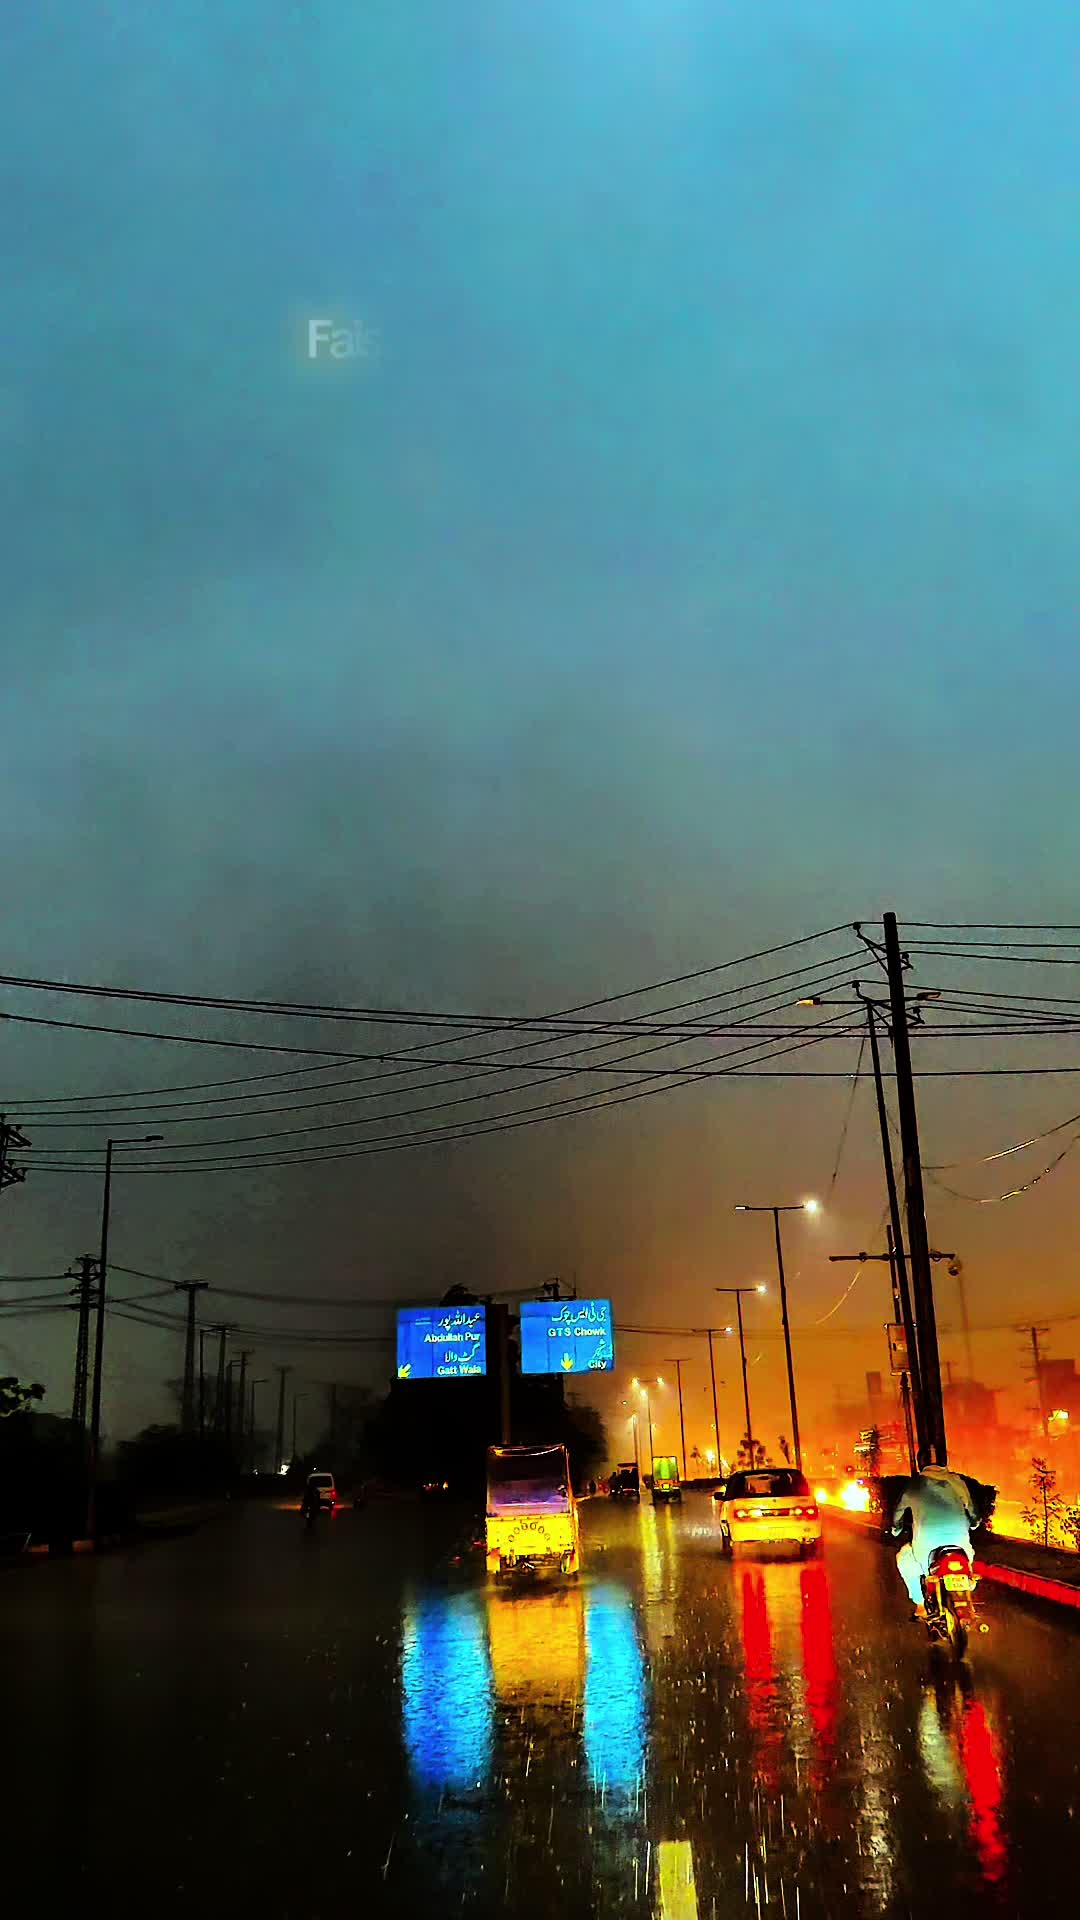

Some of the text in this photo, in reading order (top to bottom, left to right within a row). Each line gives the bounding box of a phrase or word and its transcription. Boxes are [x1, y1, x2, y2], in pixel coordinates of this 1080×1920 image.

[424, 1331, 481, 1343] Abdullah Pur
[547, 1327, 607, 1337] GTS Chowk
[437, 1364, 482, 1375] Gatt Wala
[587, 1359, 607, 1370] City
